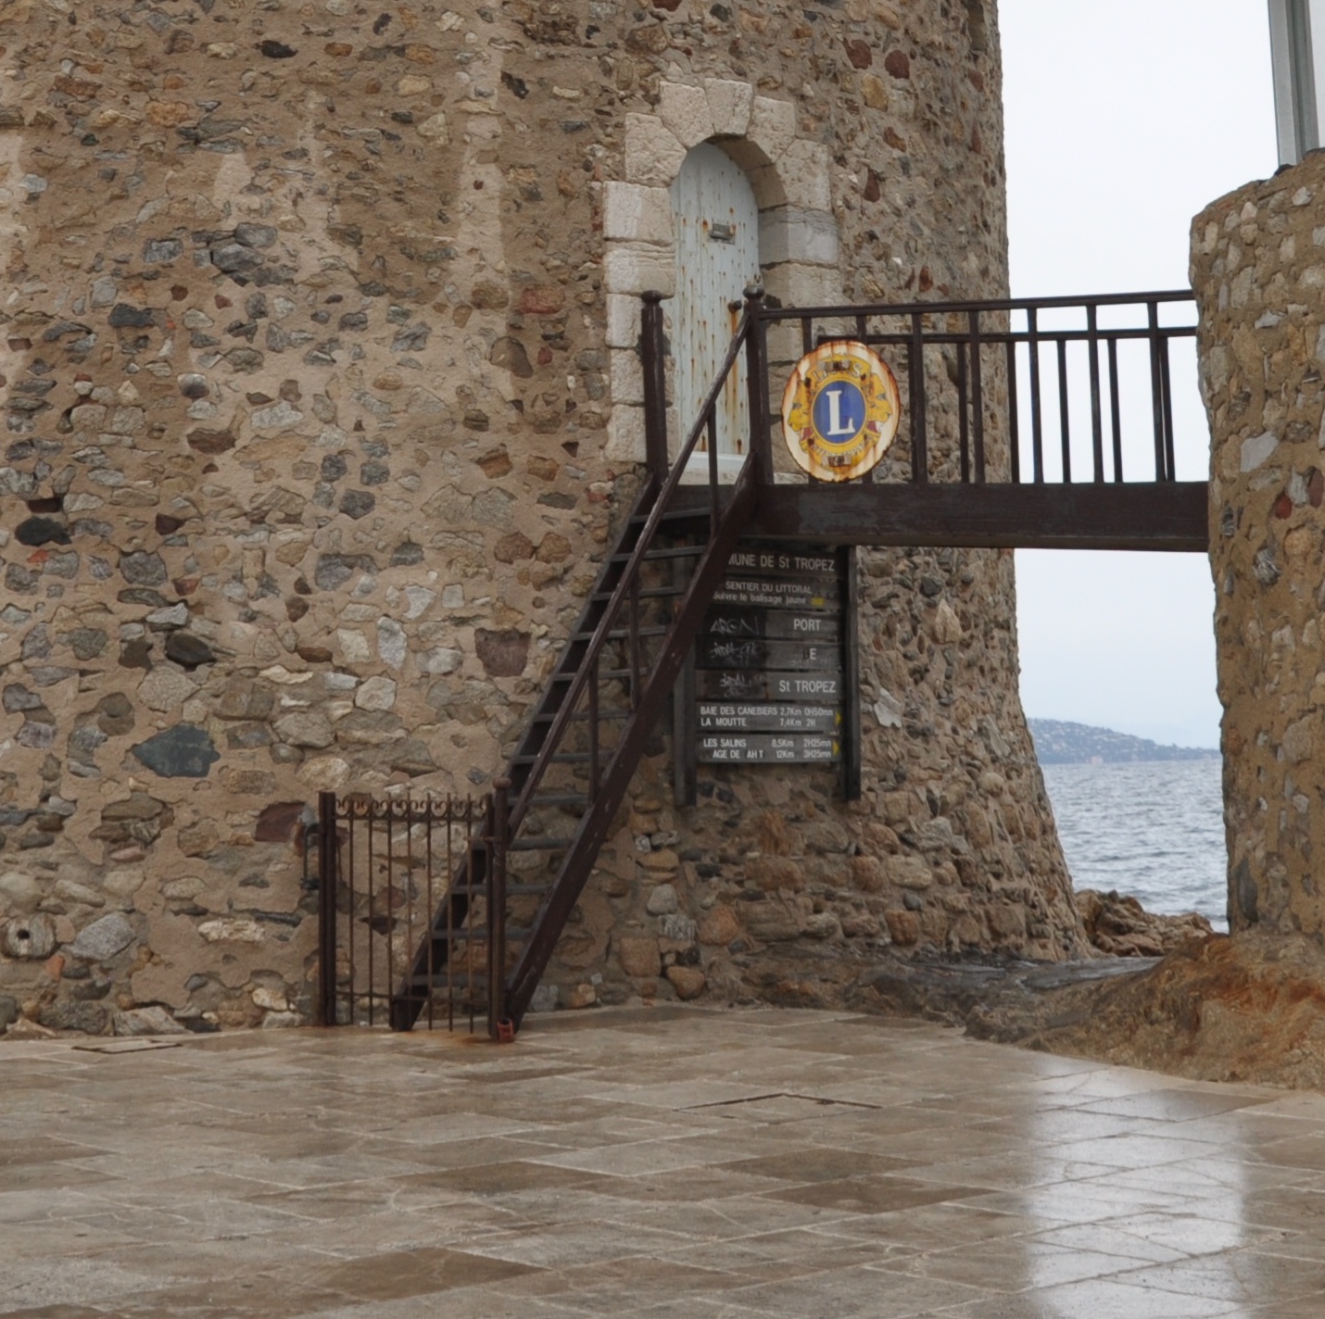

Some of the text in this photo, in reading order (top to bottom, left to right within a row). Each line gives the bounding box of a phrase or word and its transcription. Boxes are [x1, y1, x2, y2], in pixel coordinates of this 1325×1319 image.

[826, 390, 856, 436] L
[760, 555, 775, 568] DE
[779, 557, 790, 569] St
[795, 557, 835, 571] TROPEZ
[725, 581, 813, 595] SENTIER DU LITTORAL
[739, 592, 748, 601] le
[750, 592, 783, 605] balisage
[793, 618, 822, 632] PORT
[779, 679, 836, 693] St TROPEZ
[700, 706, 719, 716] BAIE
[720, 706, 735, 716] DES
[737, 706, 778, 716] CANEBIERS
[700, 717, 711, 727] LA
[716, 717, 747, 727] MOUTTE
[703, 738, 718, 748] LES
[720, 738, 746, 748] SALINS
[730, 749, 740, 759] DE
